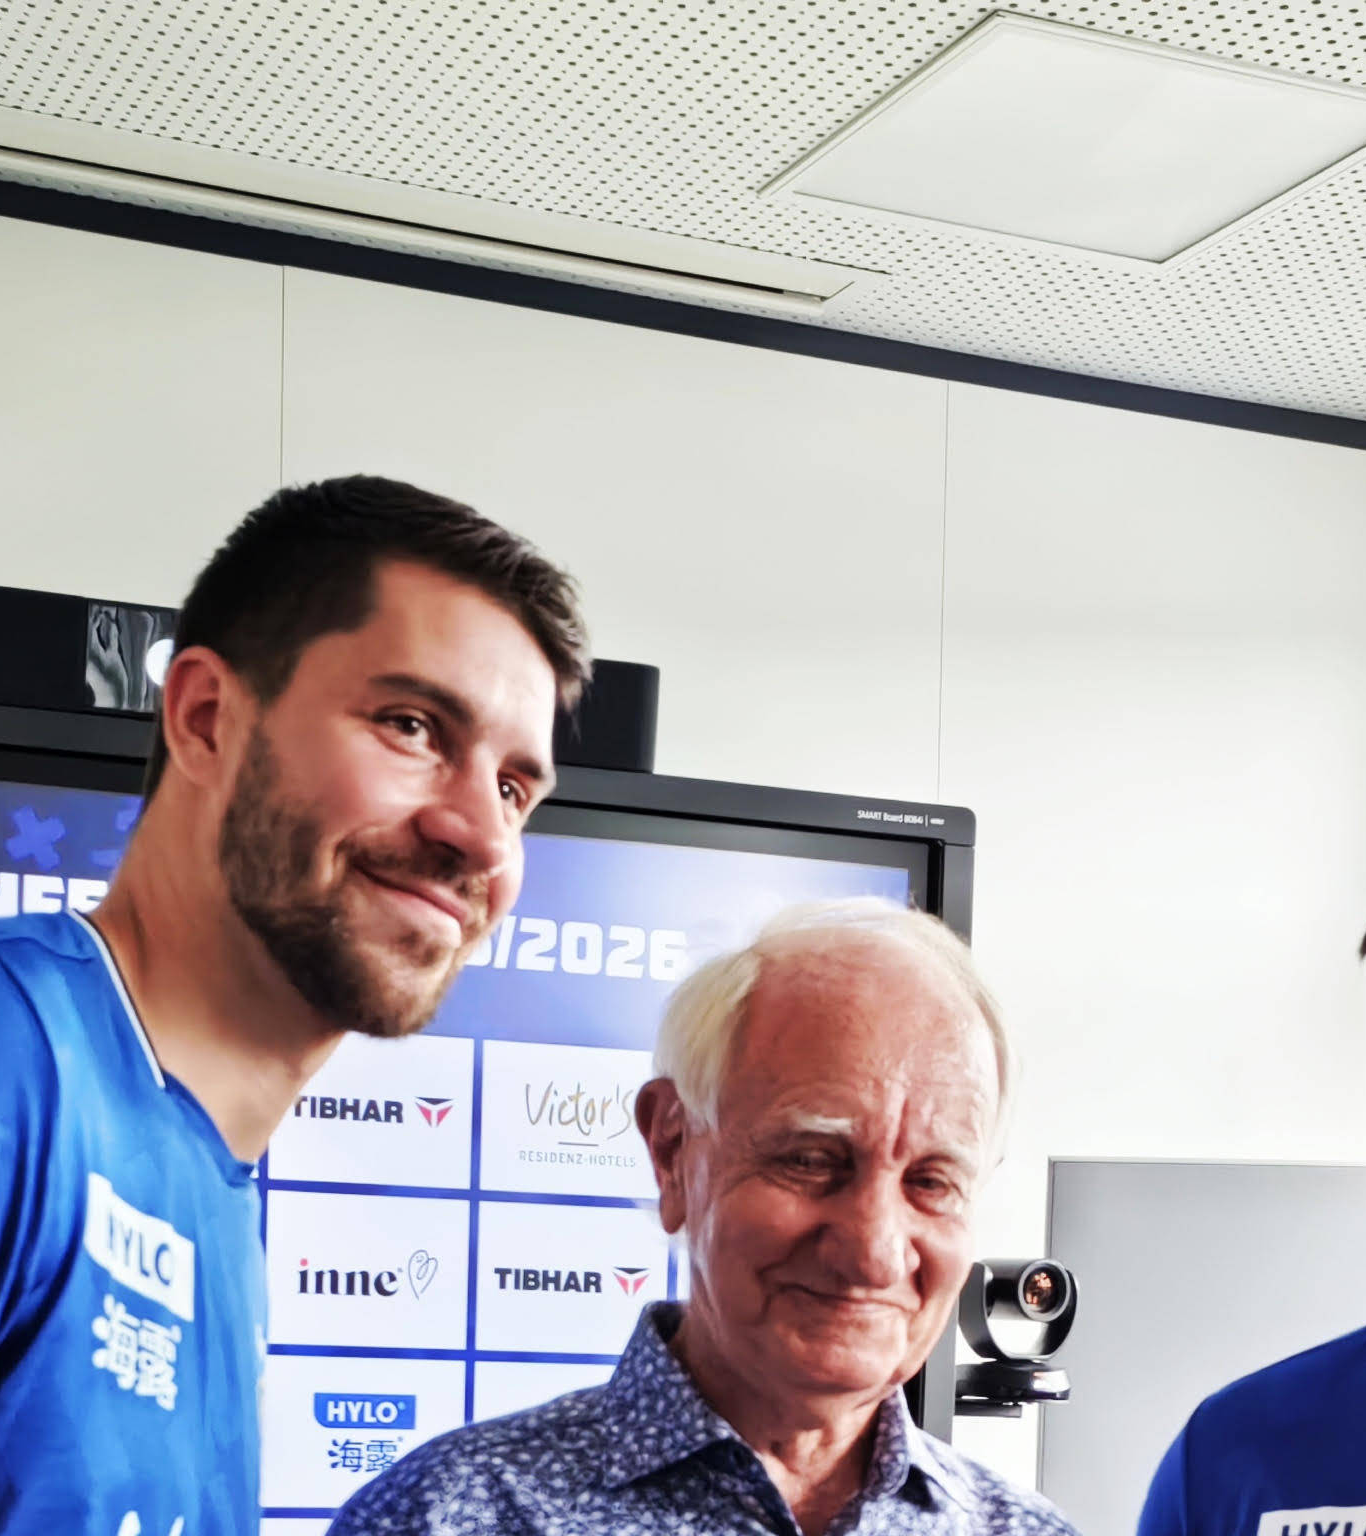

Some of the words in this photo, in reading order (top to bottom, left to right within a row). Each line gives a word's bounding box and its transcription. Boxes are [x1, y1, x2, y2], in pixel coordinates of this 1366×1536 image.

[294, 1095, 404, 1125] TIBHAR
[525, 1080, 635, 1140] Victor's
[519, 1150, 636, 1169] RESIDENZ-HOTELS
[297, 1257, 401, 1297] inne
[494, 1266, 603, 1294] TIBHAR
[327, 1400, 399, 1424] HYLO
